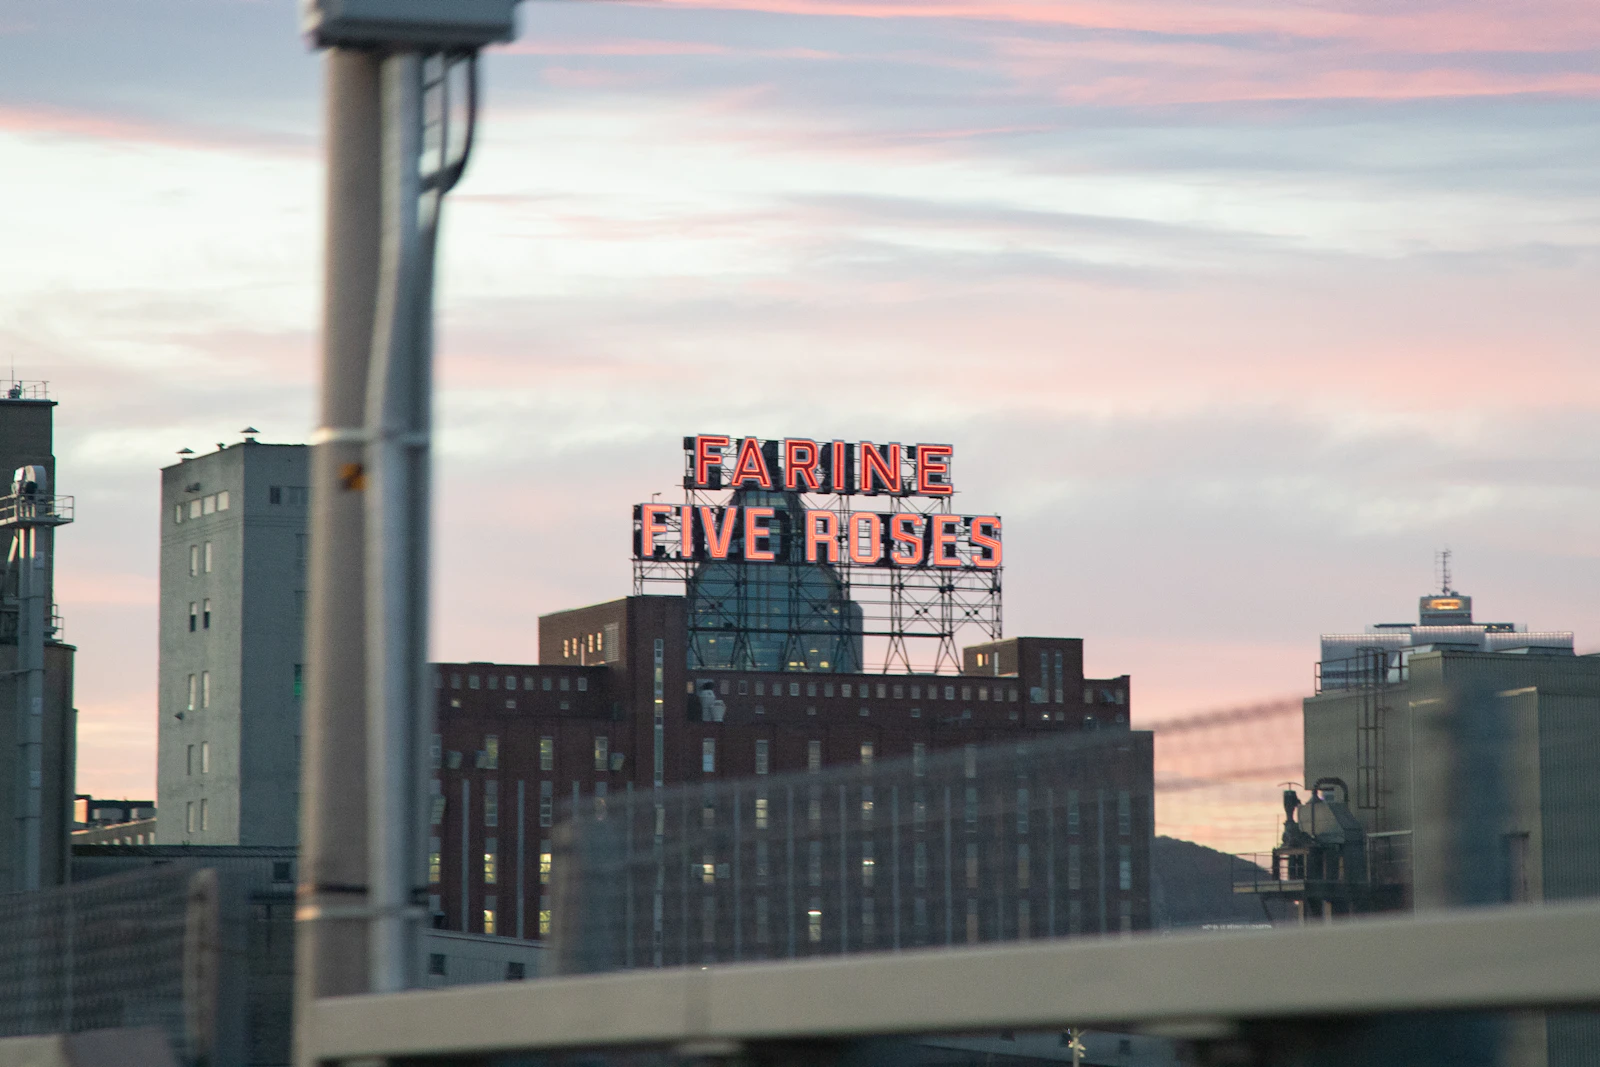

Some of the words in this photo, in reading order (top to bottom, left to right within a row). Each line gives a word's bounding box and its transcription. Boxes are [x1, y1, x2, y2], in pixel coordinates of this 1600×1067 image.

[695, 433, 954, 495] FARINE
[641, 503, 775, 561] FIVE
[805, 509, 1003, 567] ROSES
